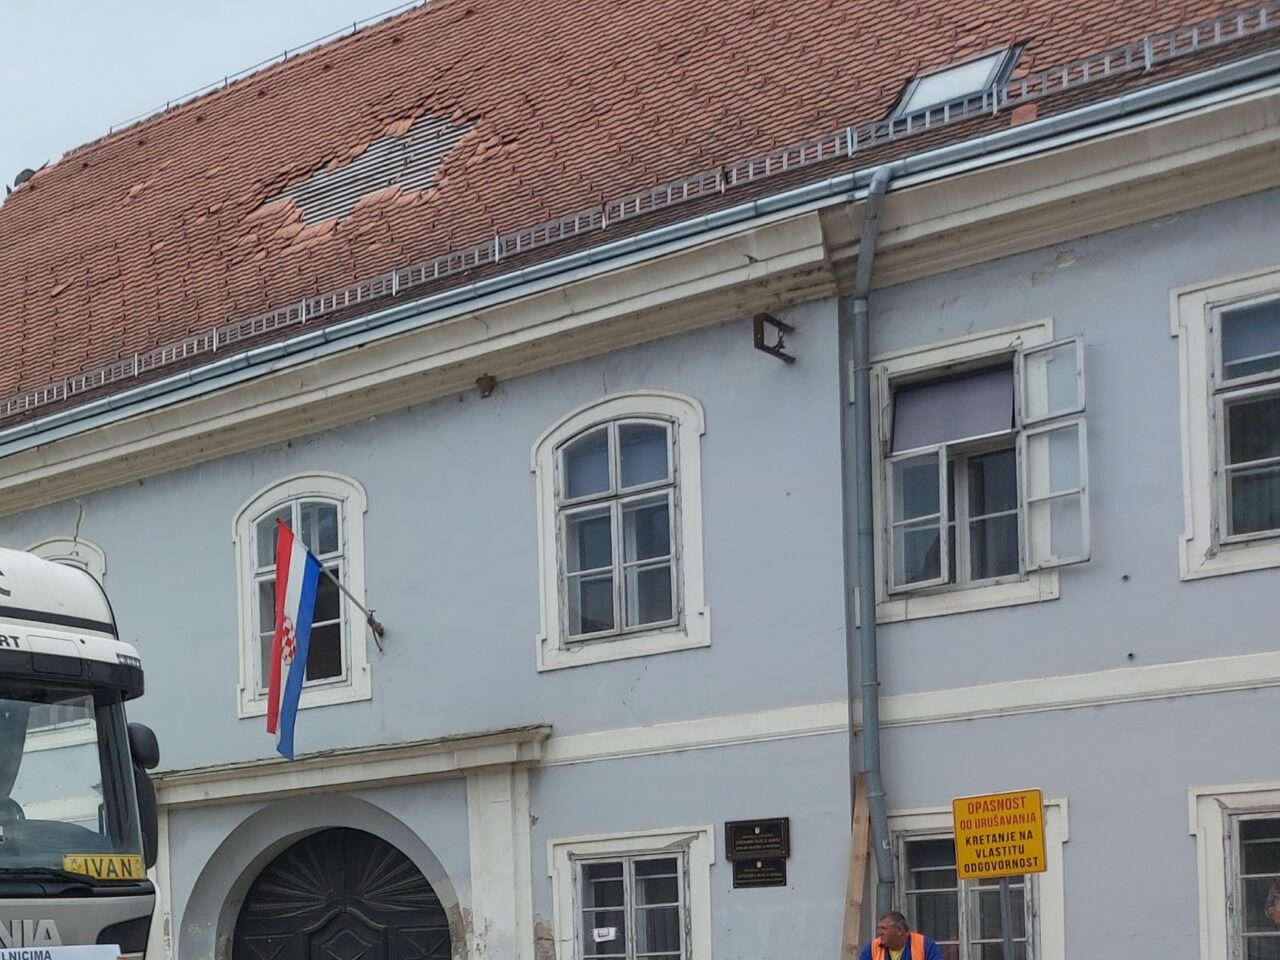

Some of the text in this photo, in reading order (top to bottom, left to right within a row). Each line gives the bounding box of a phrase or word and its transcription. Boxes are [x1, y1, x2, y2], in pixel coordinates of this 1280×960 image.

[967, 796, 1027, 815] OPASNOST
[960, 812, 1037, 830] OD URUŠAVANJA
[965, 830, 1034, 846] KRETANJE NA
[975, 844, 1025, 859] VLASTITU
[83, 858, 133, 878] IVAN
[964, 857, 1039, 873] ODGOVORNOST
